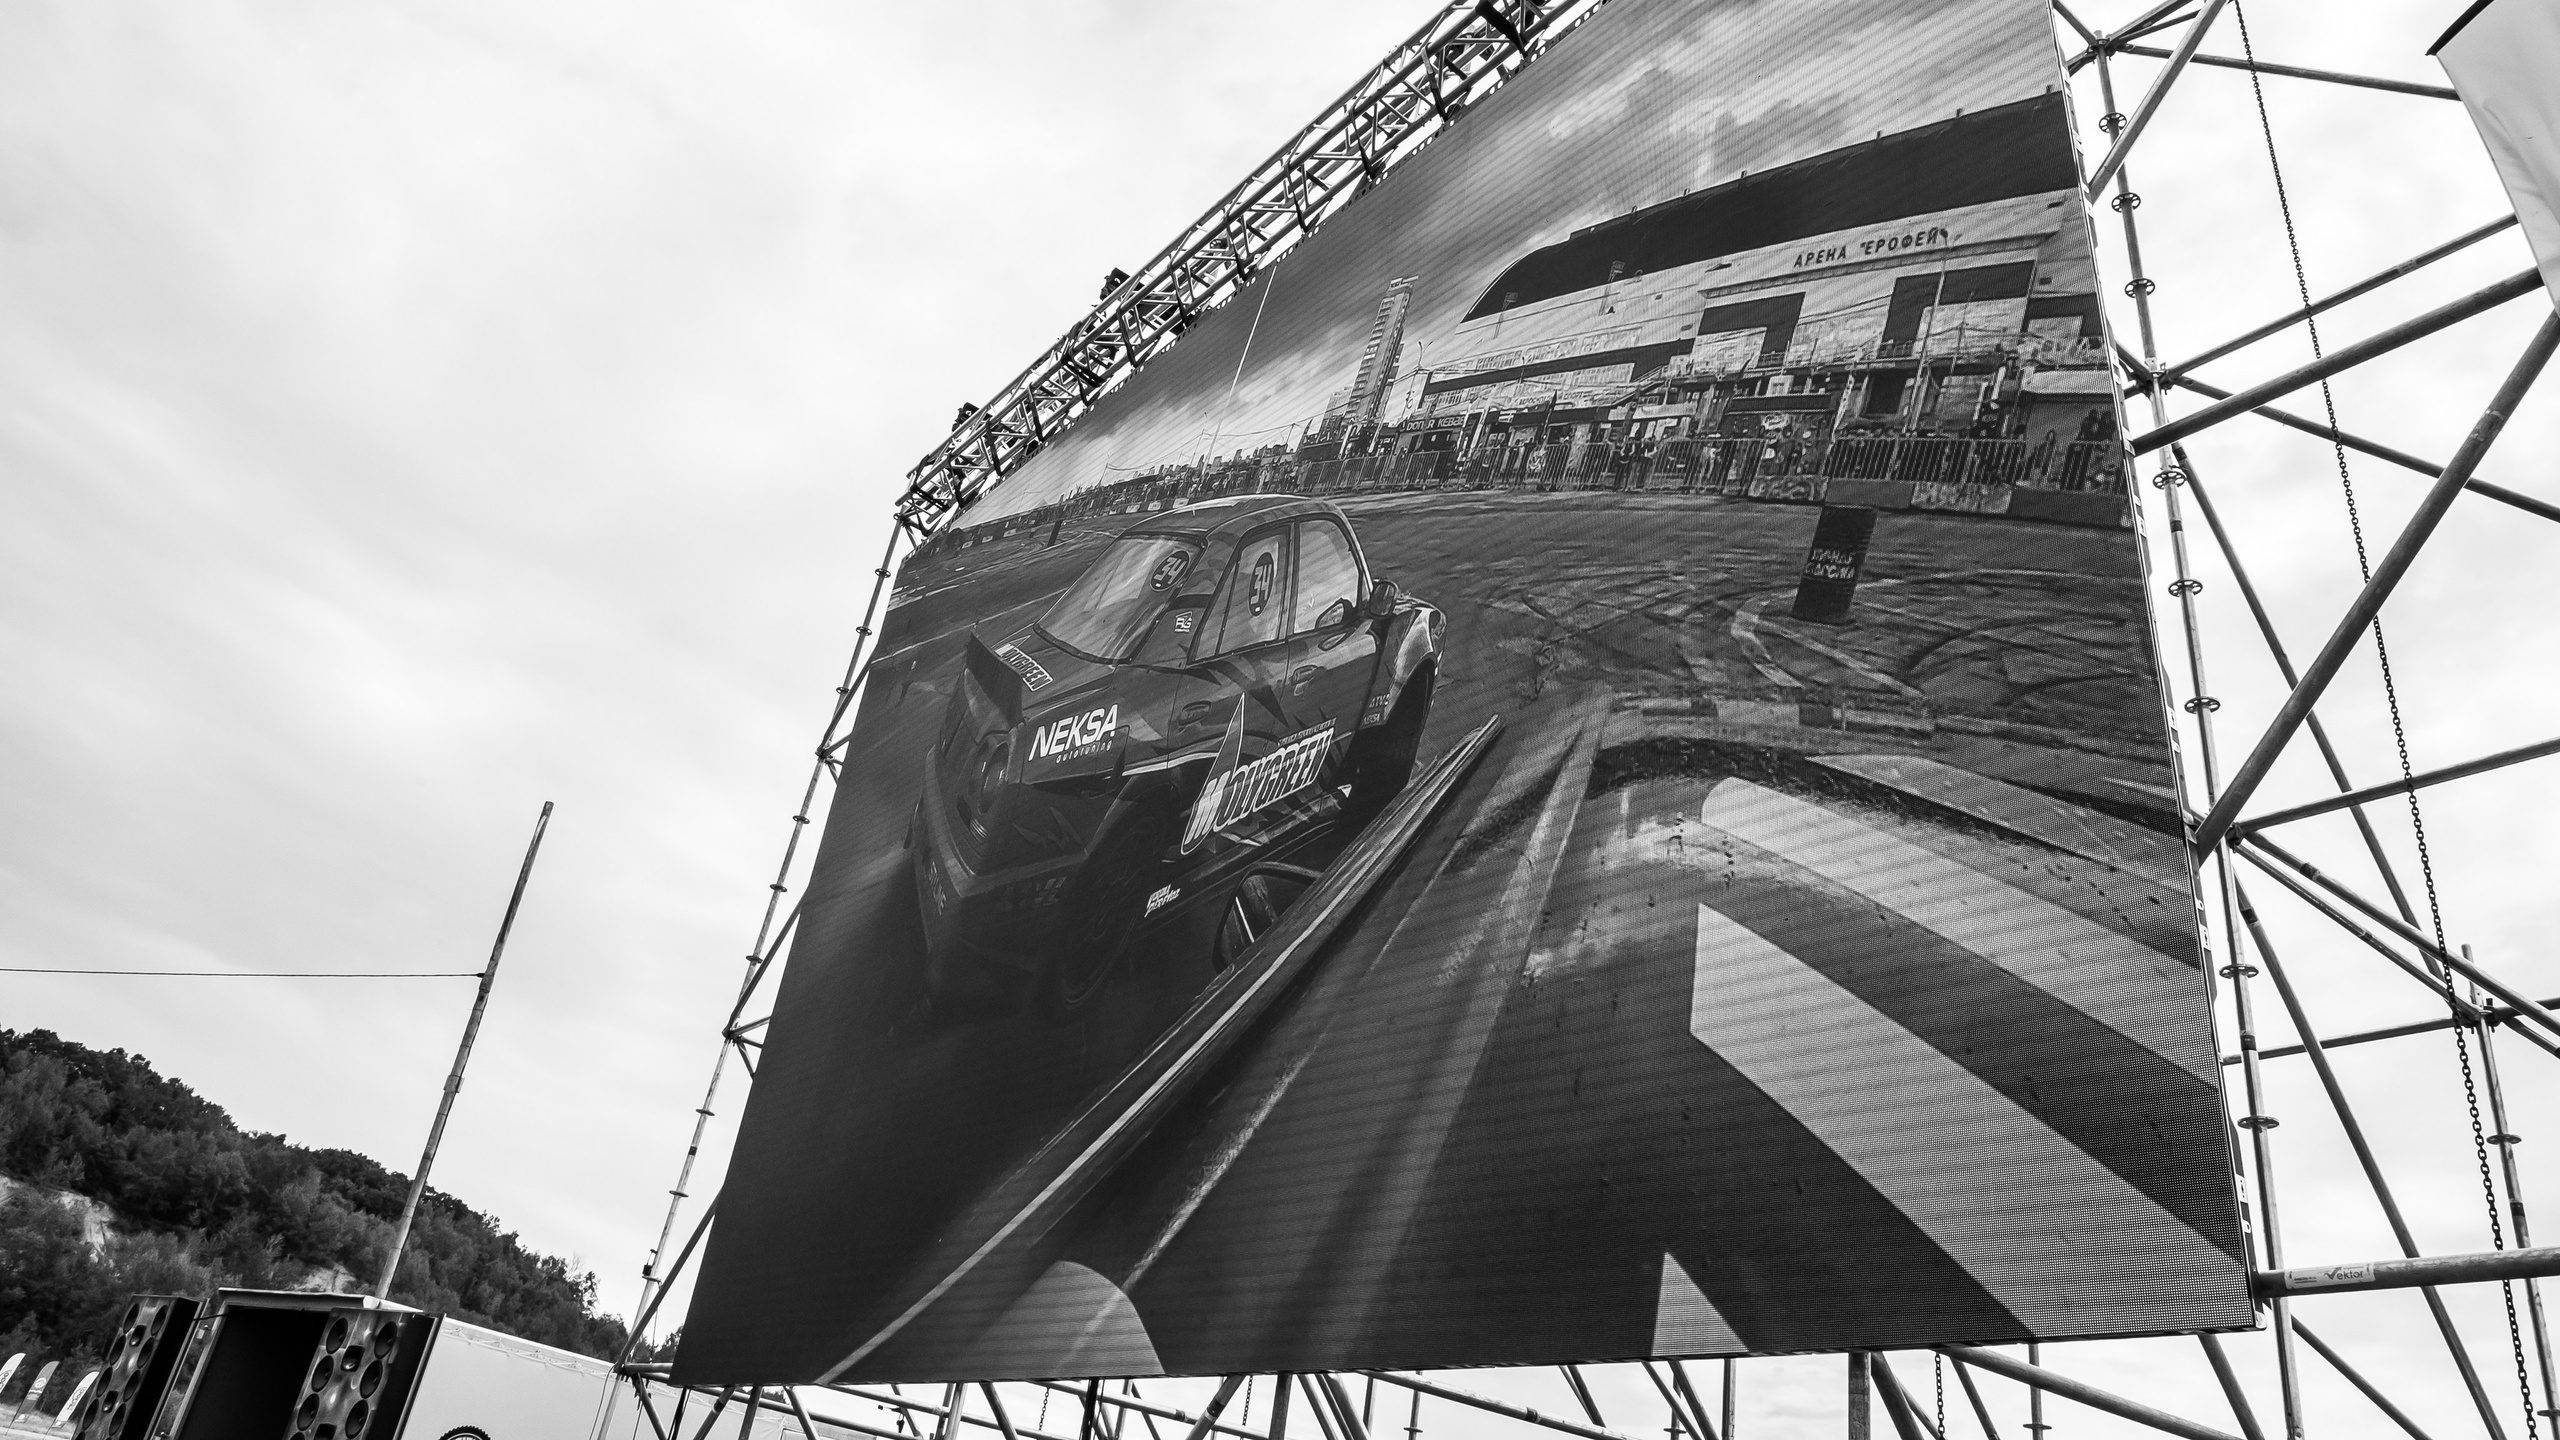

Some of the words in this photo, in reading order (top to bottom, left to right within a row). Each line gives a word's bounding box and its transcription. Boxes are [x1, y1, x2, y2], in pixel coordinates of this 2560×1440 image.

[1793, 243, 1847, 269] АРЕНА
[1405, 419, 1436, 432] DONR
[1153, 556, 1188, 586] 34
[1250, 563, 1273, 605] 34
[1028, 704, 1118, 762] NEKSA
[1056, 740, 1113, 764] autotuning
[1182, 726, 1335, 854] MOLYGREEN
[2323, 1266, 2364, 1281] Vektor
